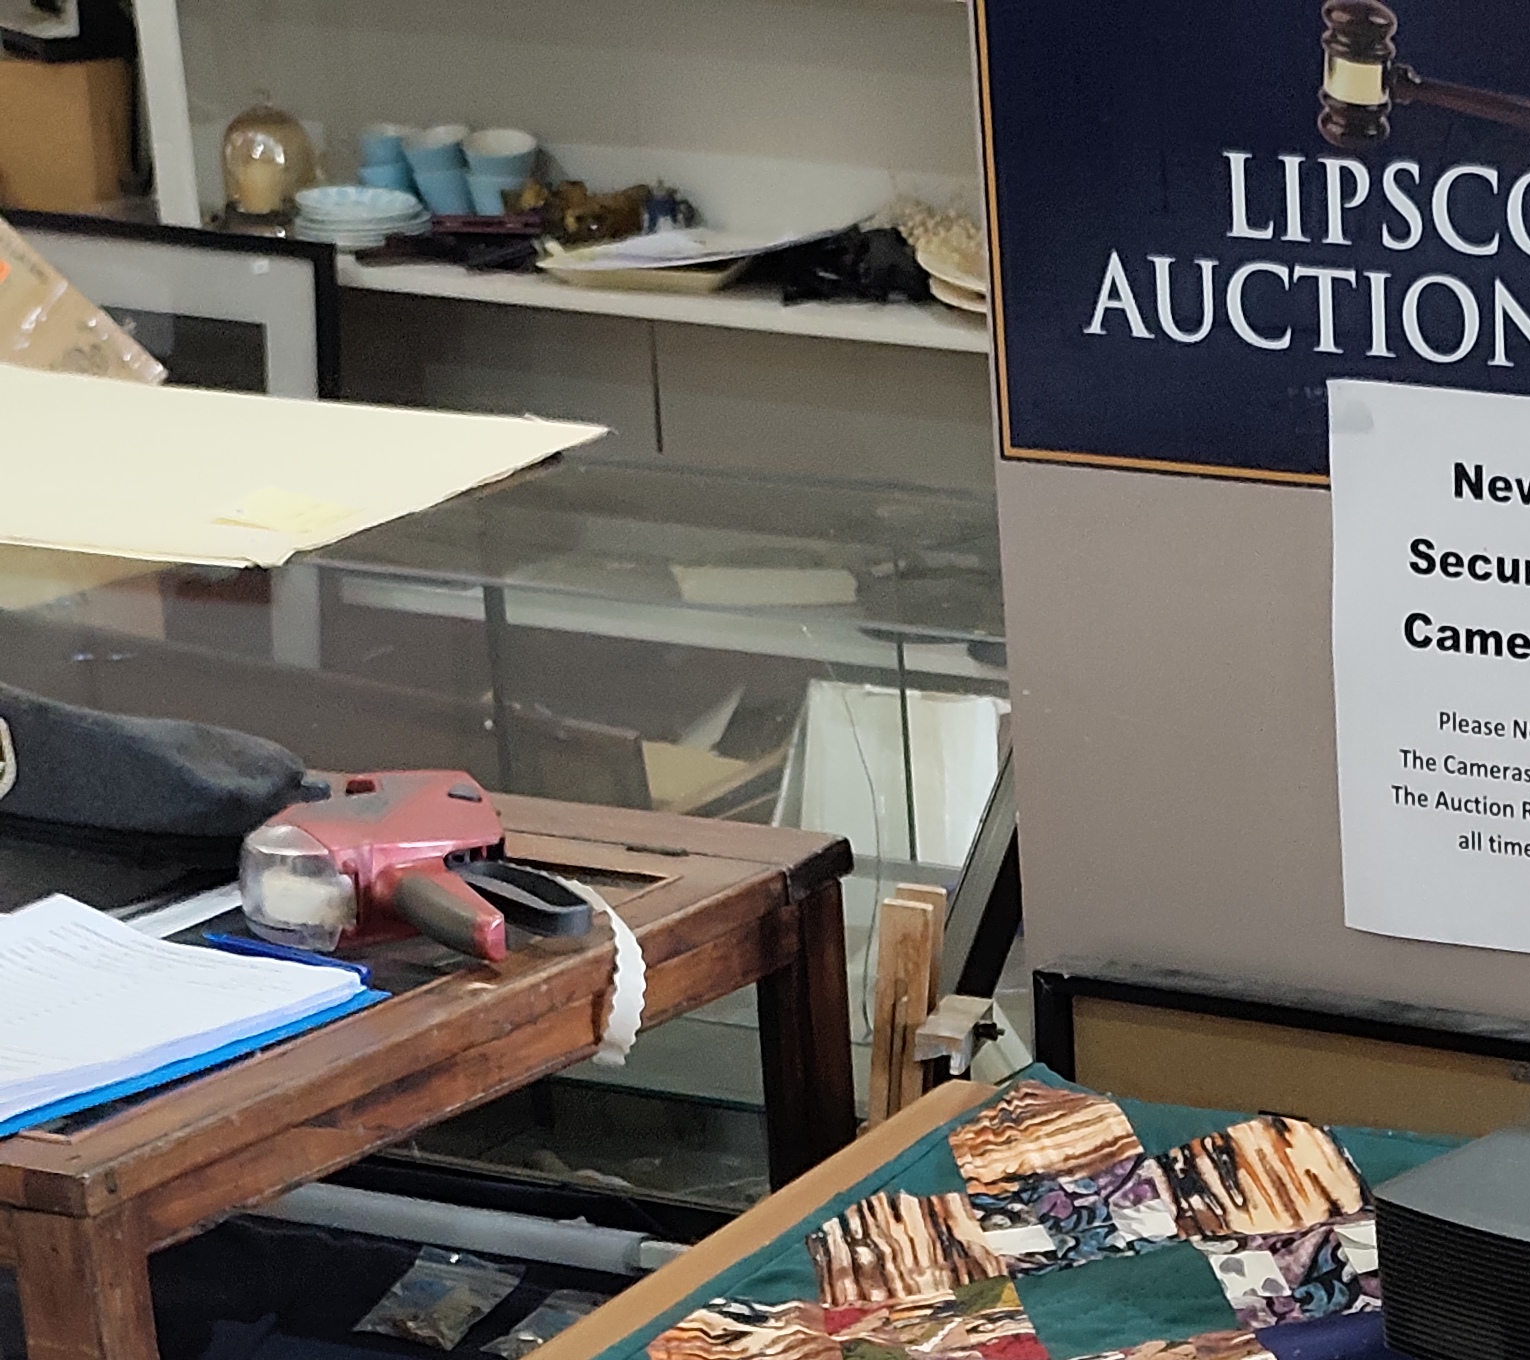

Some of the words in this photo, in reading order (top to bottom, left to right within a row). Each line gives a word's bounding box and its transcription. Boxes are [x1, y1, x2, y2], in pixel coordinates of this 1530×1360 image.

[1438, 711, 1506, 737] Please
[1399, 749, 1437, 772] The
[1391, 785, 1428, 808] The
[1435, 791, 1515, 819] Auction
[1458, 831, 1482, 851] all
